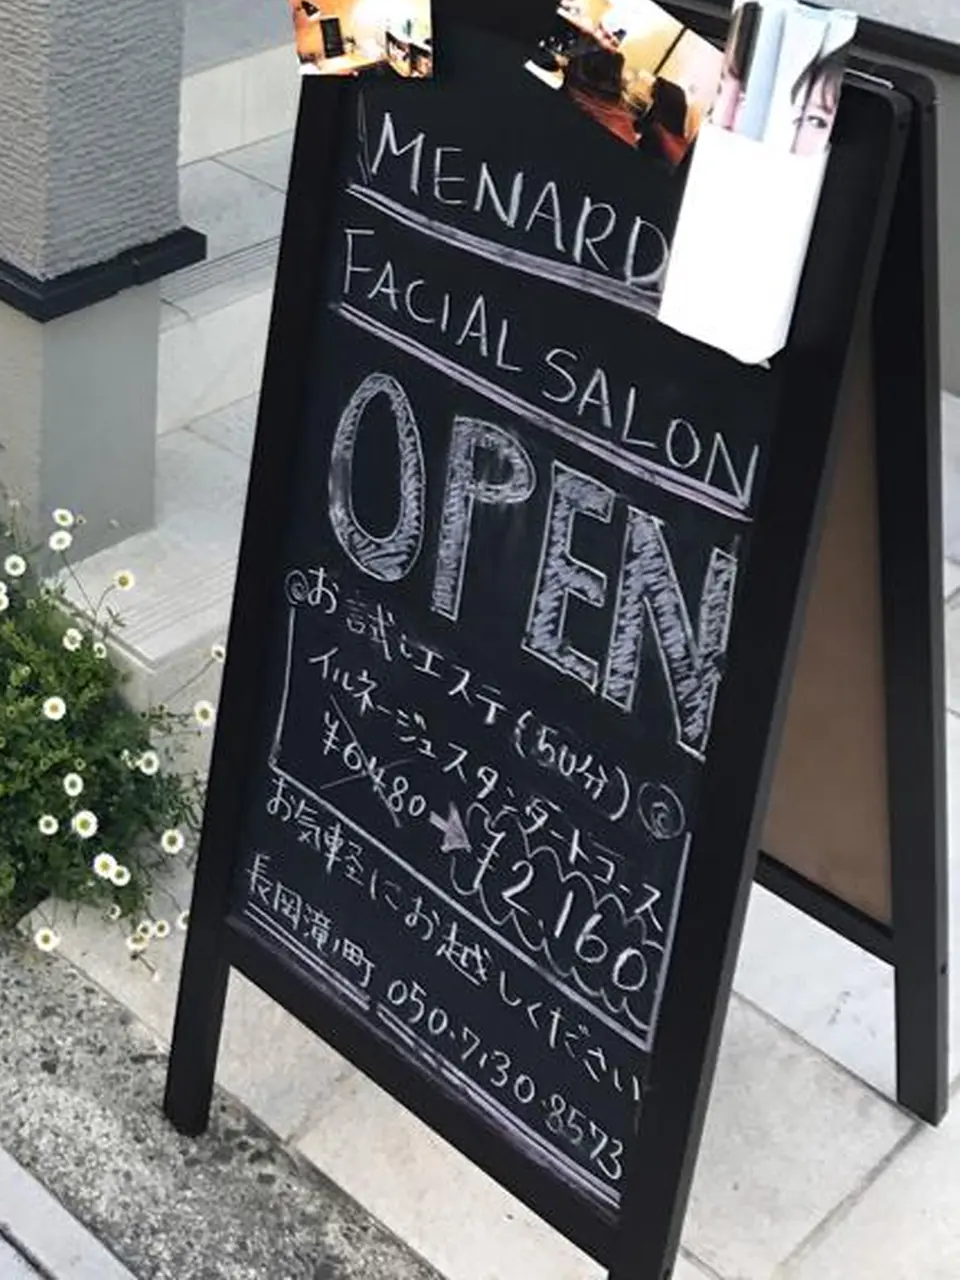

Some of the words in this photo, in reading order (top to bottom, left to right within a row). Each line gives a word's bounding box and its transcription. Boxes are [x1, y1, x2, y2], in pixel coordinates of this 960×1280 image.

[368, 111, 670, 286] MENARD
[343, 228, 523, 372] FACIAL
[541, 346, 761, 512] SALON
[328, 372, 739, 762] OPEN
